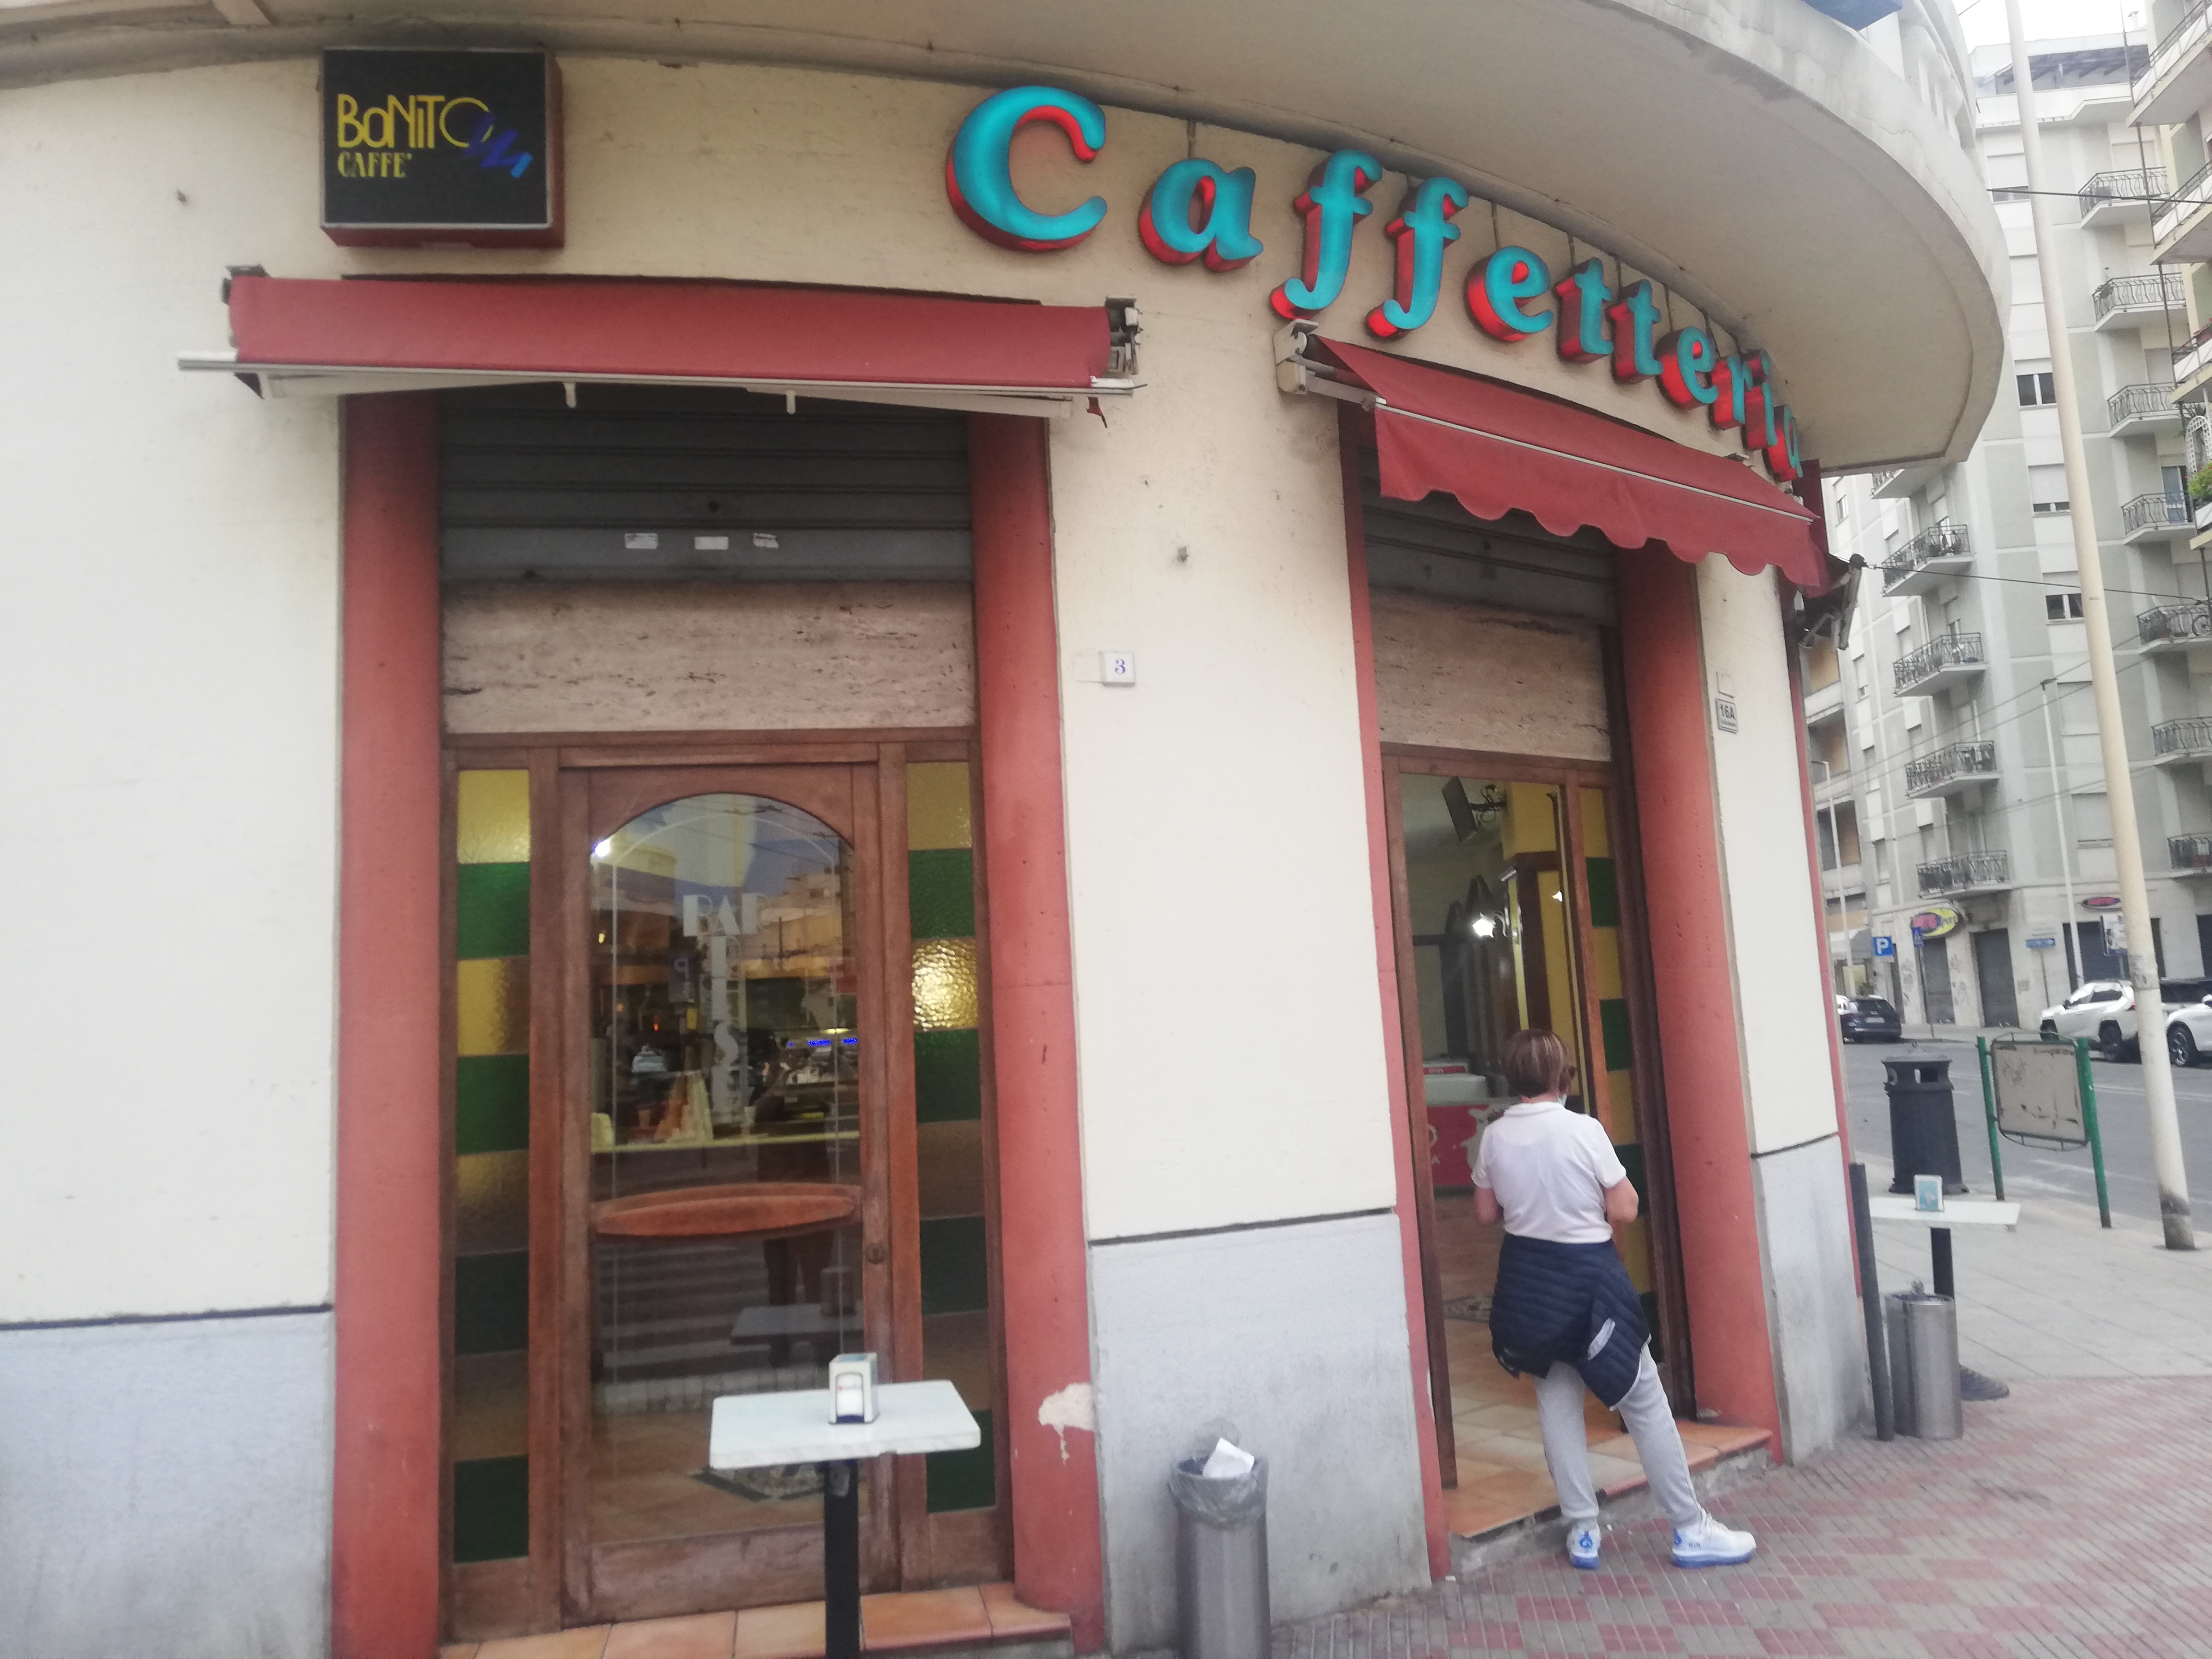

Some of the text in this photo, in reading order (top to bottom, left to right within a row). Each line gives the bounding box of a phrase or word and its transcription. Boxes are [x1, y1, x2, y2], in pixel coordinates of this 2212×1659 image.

[946, 85, 1803, 481] Caffetteria
[1115, 659, 1126, 674] 3
[1720, 703, 1736, 721] 16A
[1876, 938, 1889, 955] P
